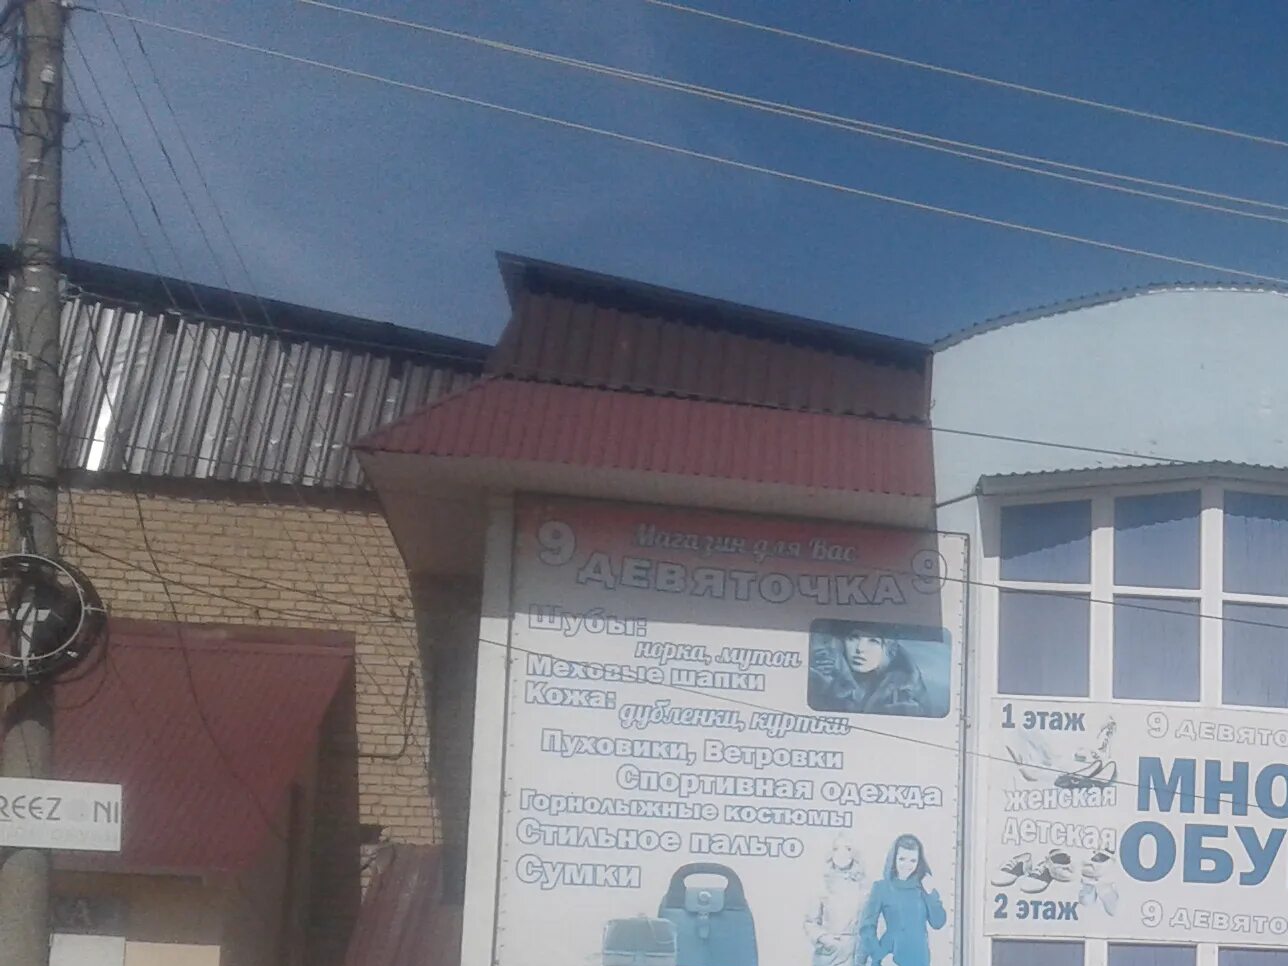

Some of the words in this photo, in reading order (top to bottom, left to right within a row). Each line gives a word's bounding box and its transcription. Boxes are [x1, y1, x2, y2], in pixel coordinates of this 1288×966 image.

[538, 520, 576, 566] 9
[806, 538, 858, 564] Вас
[576, 556, 907, 606] ДЕВЯТОЧКА
[911, 549, 947, 596] 9
[527, 604, 648, 637] Шубы:
[526, 654, 665, 685] Меховые
[670, 667, 766, 692] шапки
[634, 639, 713, 668] норка,
[715, 646, 803, 672] мутон
[525, 681, 617, 709] Кожа:
[618, 700, 746, 732] дубленки,
[749, 713, 851, 736] куртки
[1001, 703, 1016, 729] 1
[1022, 710, 1086, 732] этаж
[1146, 711, 1169, 740] 9
[541, 729, 696, 765] Пуховики,
[703, 739, 844, 771] Ветровки
[616, 763, 815, 801] Спортивная
[820, 781, 943, 808] одежда
[1003, 784, 1117, 812] женская
[520, 788, 720, 822] Горнолыжные
[723, 803, 853, 828] костюмы
[516, 817, 682, 853] Стильное
[689, 833, 805, 859] пальто
[1001, 816, 1117, 850] детская
[516, 854, 641, 891] Сумки
[993, 893, 1009, 920] 2
[1015, 898, 1080, 923] этаж
[1140, 900, 1163, 929] 9
